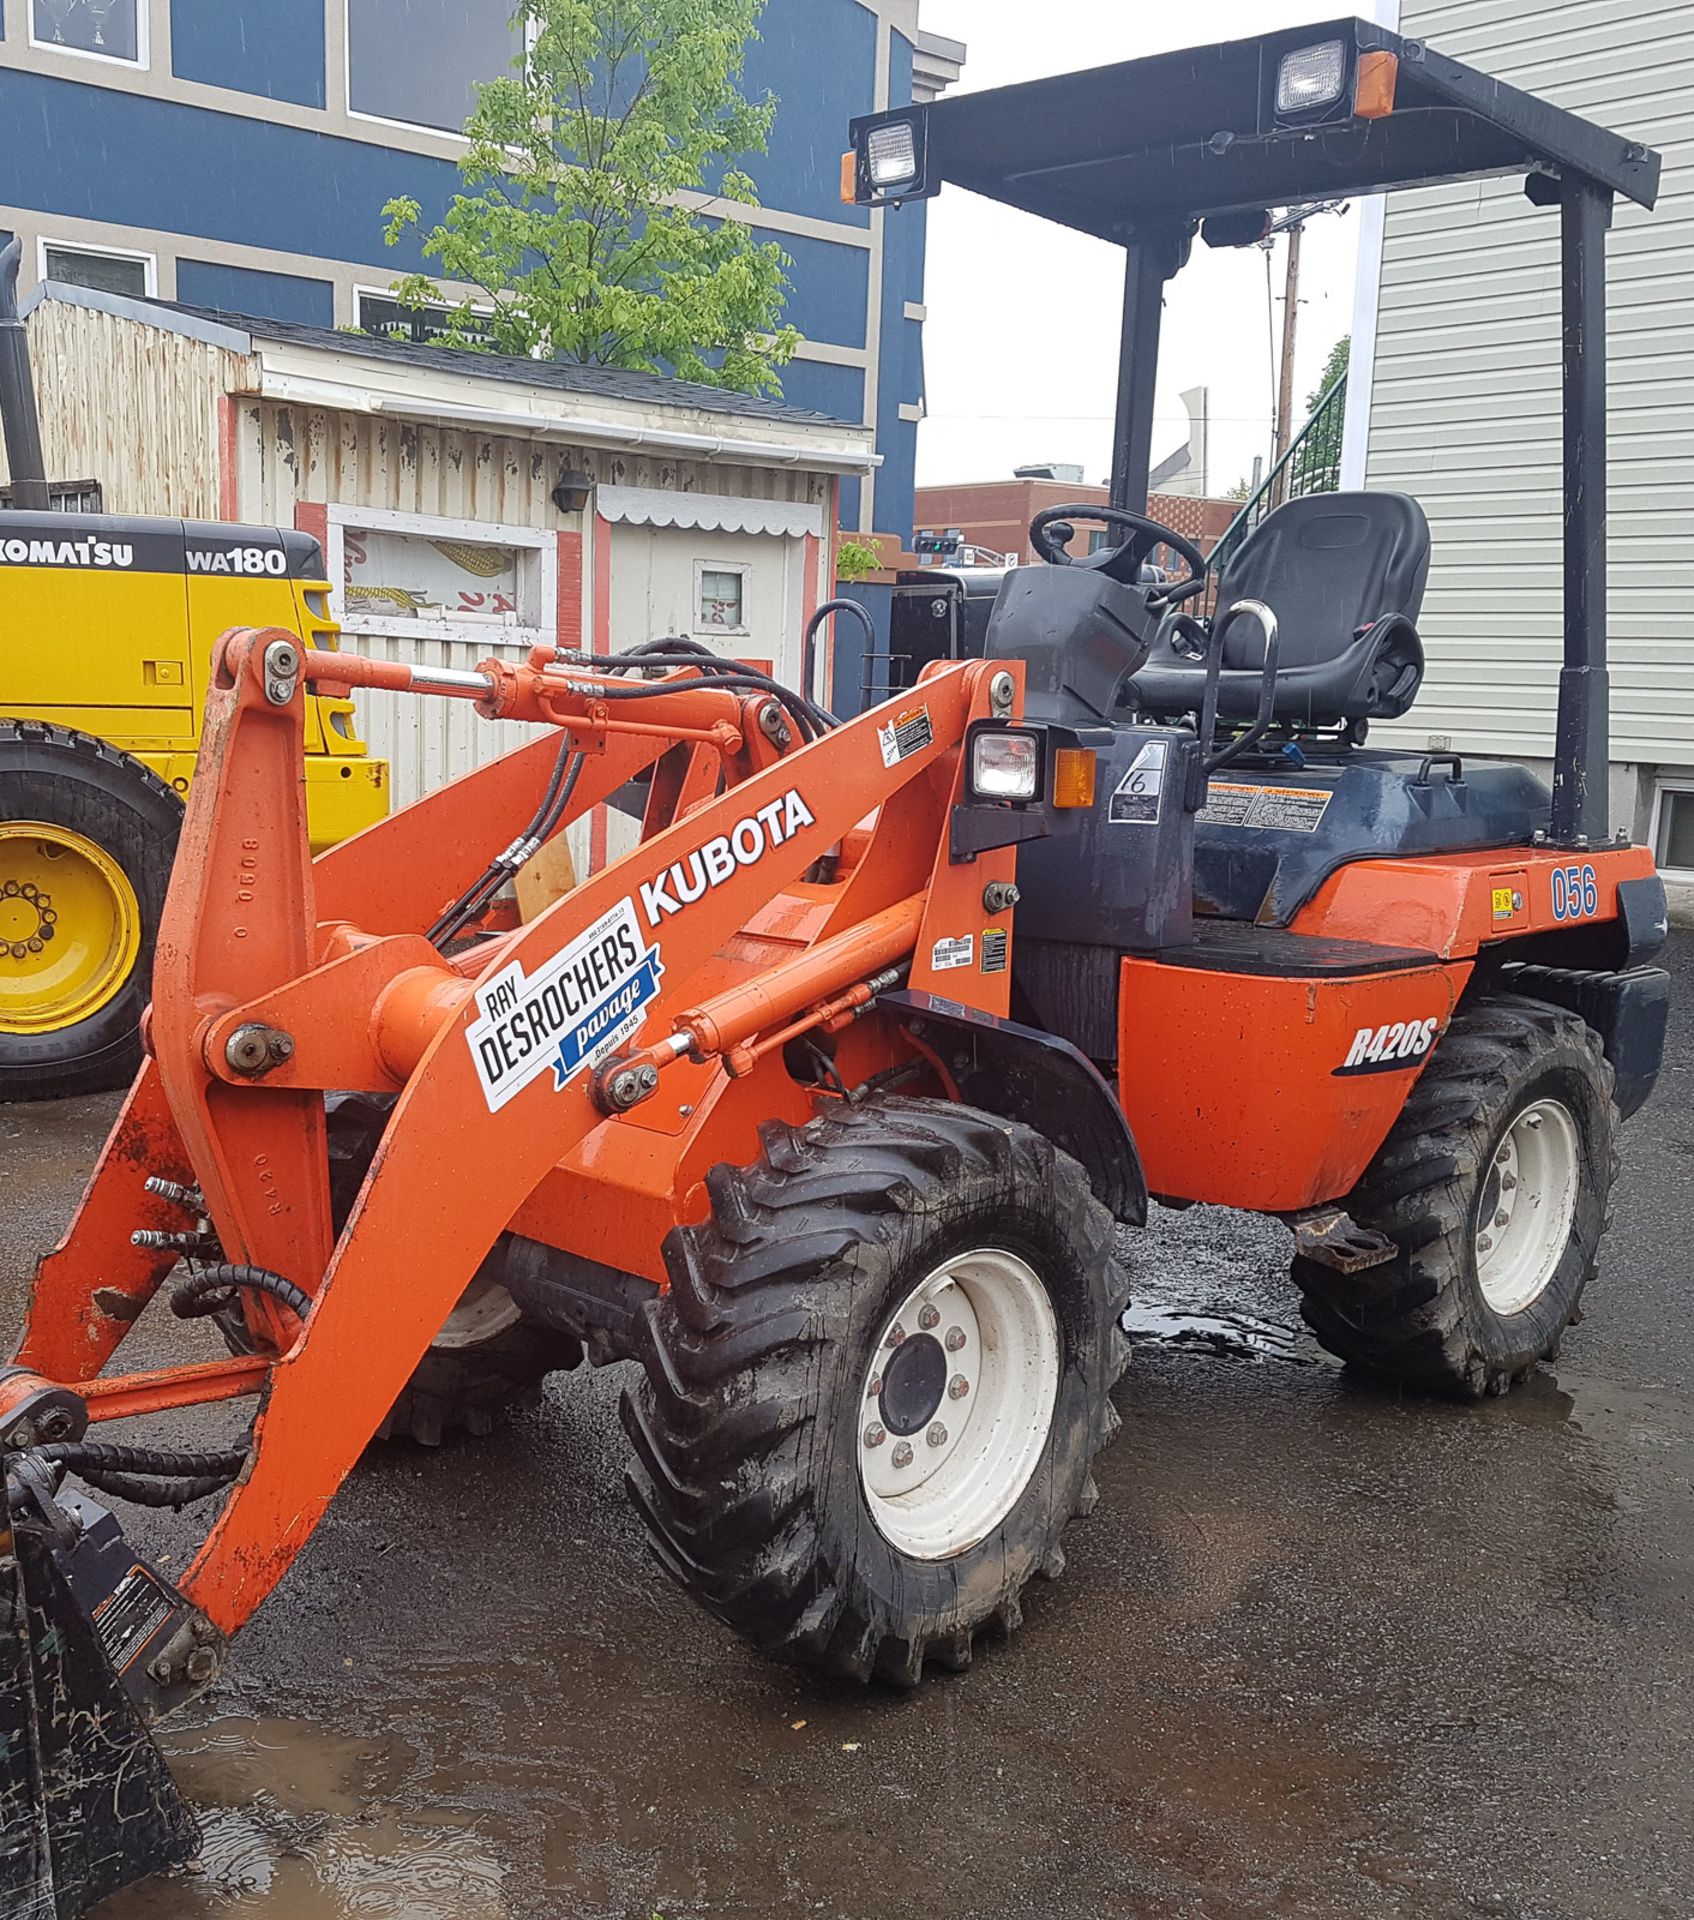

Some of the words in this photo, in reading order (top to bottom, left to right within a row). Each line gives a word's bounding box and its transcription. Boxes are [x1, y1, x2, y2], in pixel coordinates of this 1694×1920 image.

[186, 548, 287, 574] WA180
[639, 788, 816, 927] KUBOTA
[1551, 864, 1598, 921] 056
[479, 923, 637, 1085] DESROCHERS
[485, 975, 518, 1022] RAY
[576, 978, 642, 1056] pavage
[620, 1016, 639, 1036] 1945
[1343, 1017, 1438, 1067] R420S
